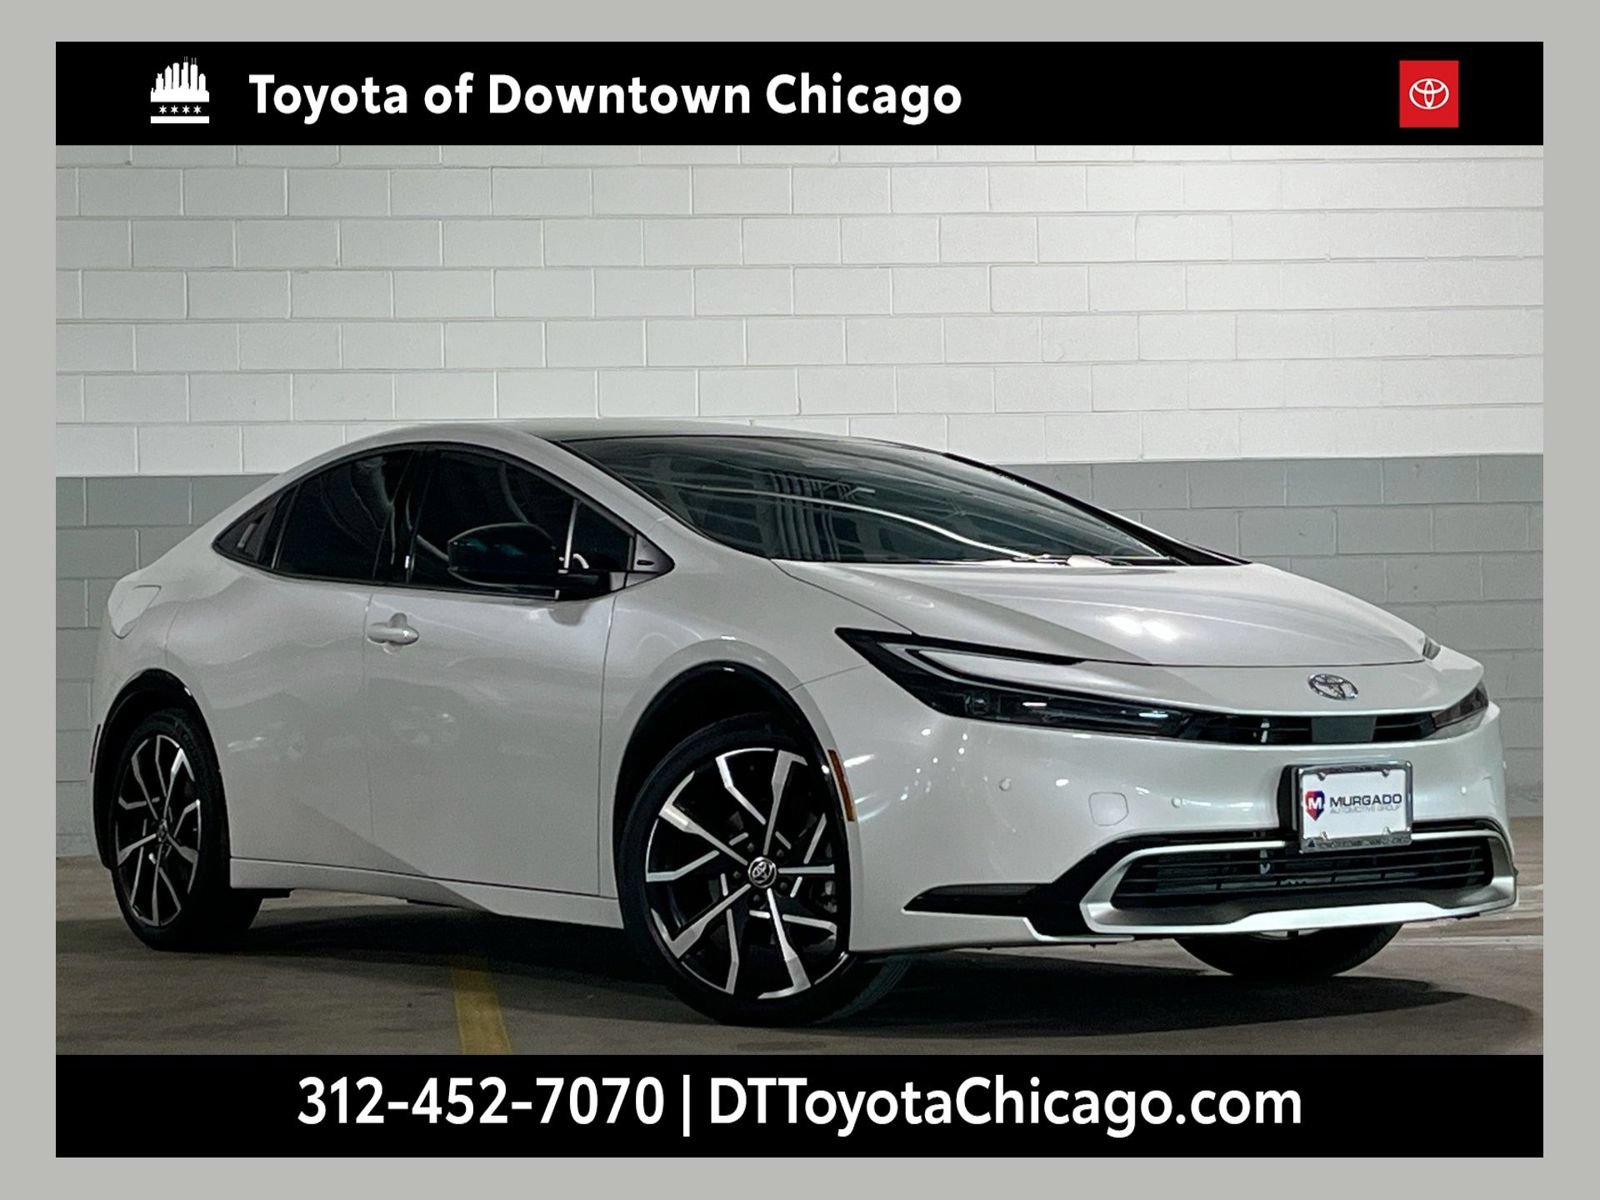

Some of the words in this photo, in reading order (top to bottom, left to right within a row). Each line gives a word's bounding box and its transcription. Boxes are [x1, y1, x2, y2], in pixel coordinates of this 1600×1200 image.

[1308, 797, 1323, 810] M
[1330, 793, 1402, 807] MURGADO
[1376, 804, 1401, 812] GROUP
